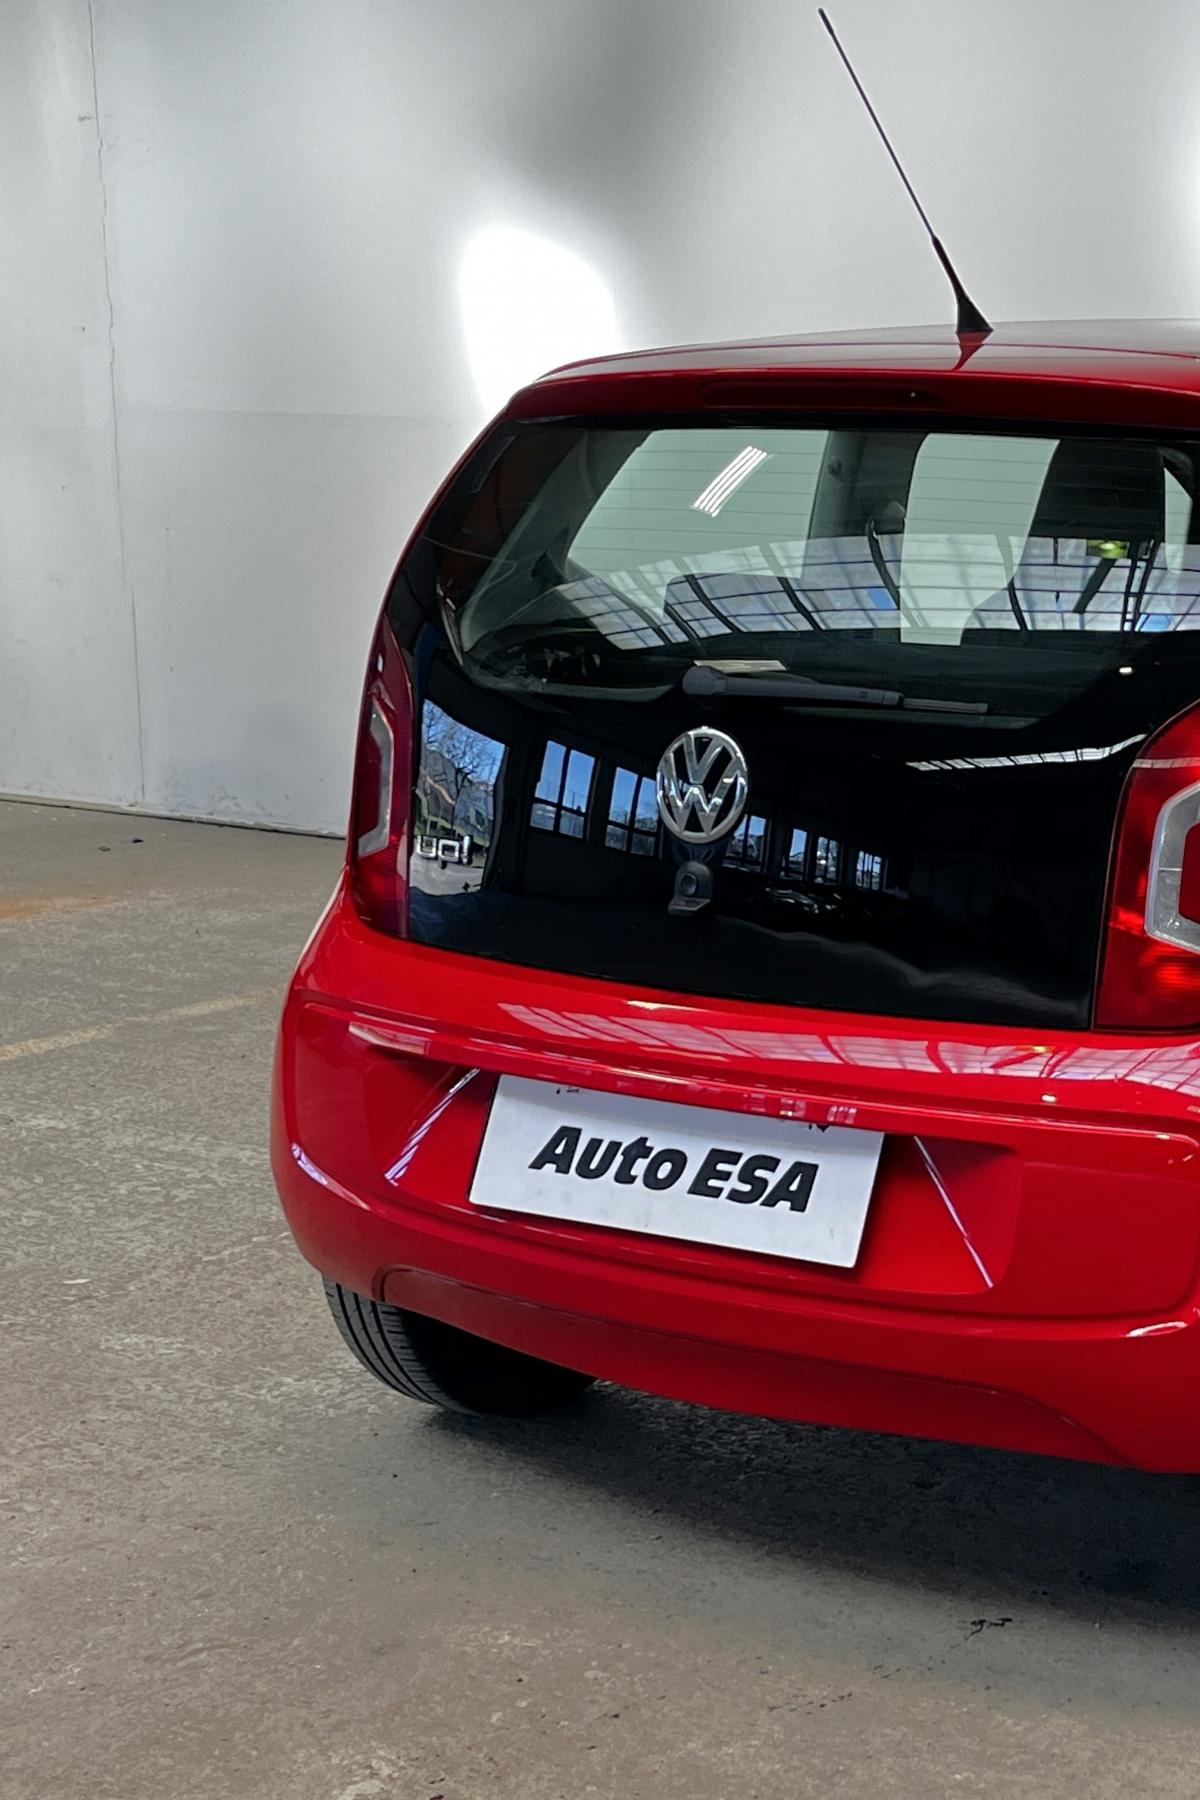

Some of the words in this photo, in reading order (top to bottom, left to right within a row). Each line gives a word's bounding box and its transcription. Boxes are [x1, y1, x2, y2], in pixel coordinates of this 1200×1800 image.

[656, 726, 748, 844] VW
[416, 834, 472, 869] up!
[528, 1125, 688, 1191] Auto
[687, 1148, 819, 1213] ESA
